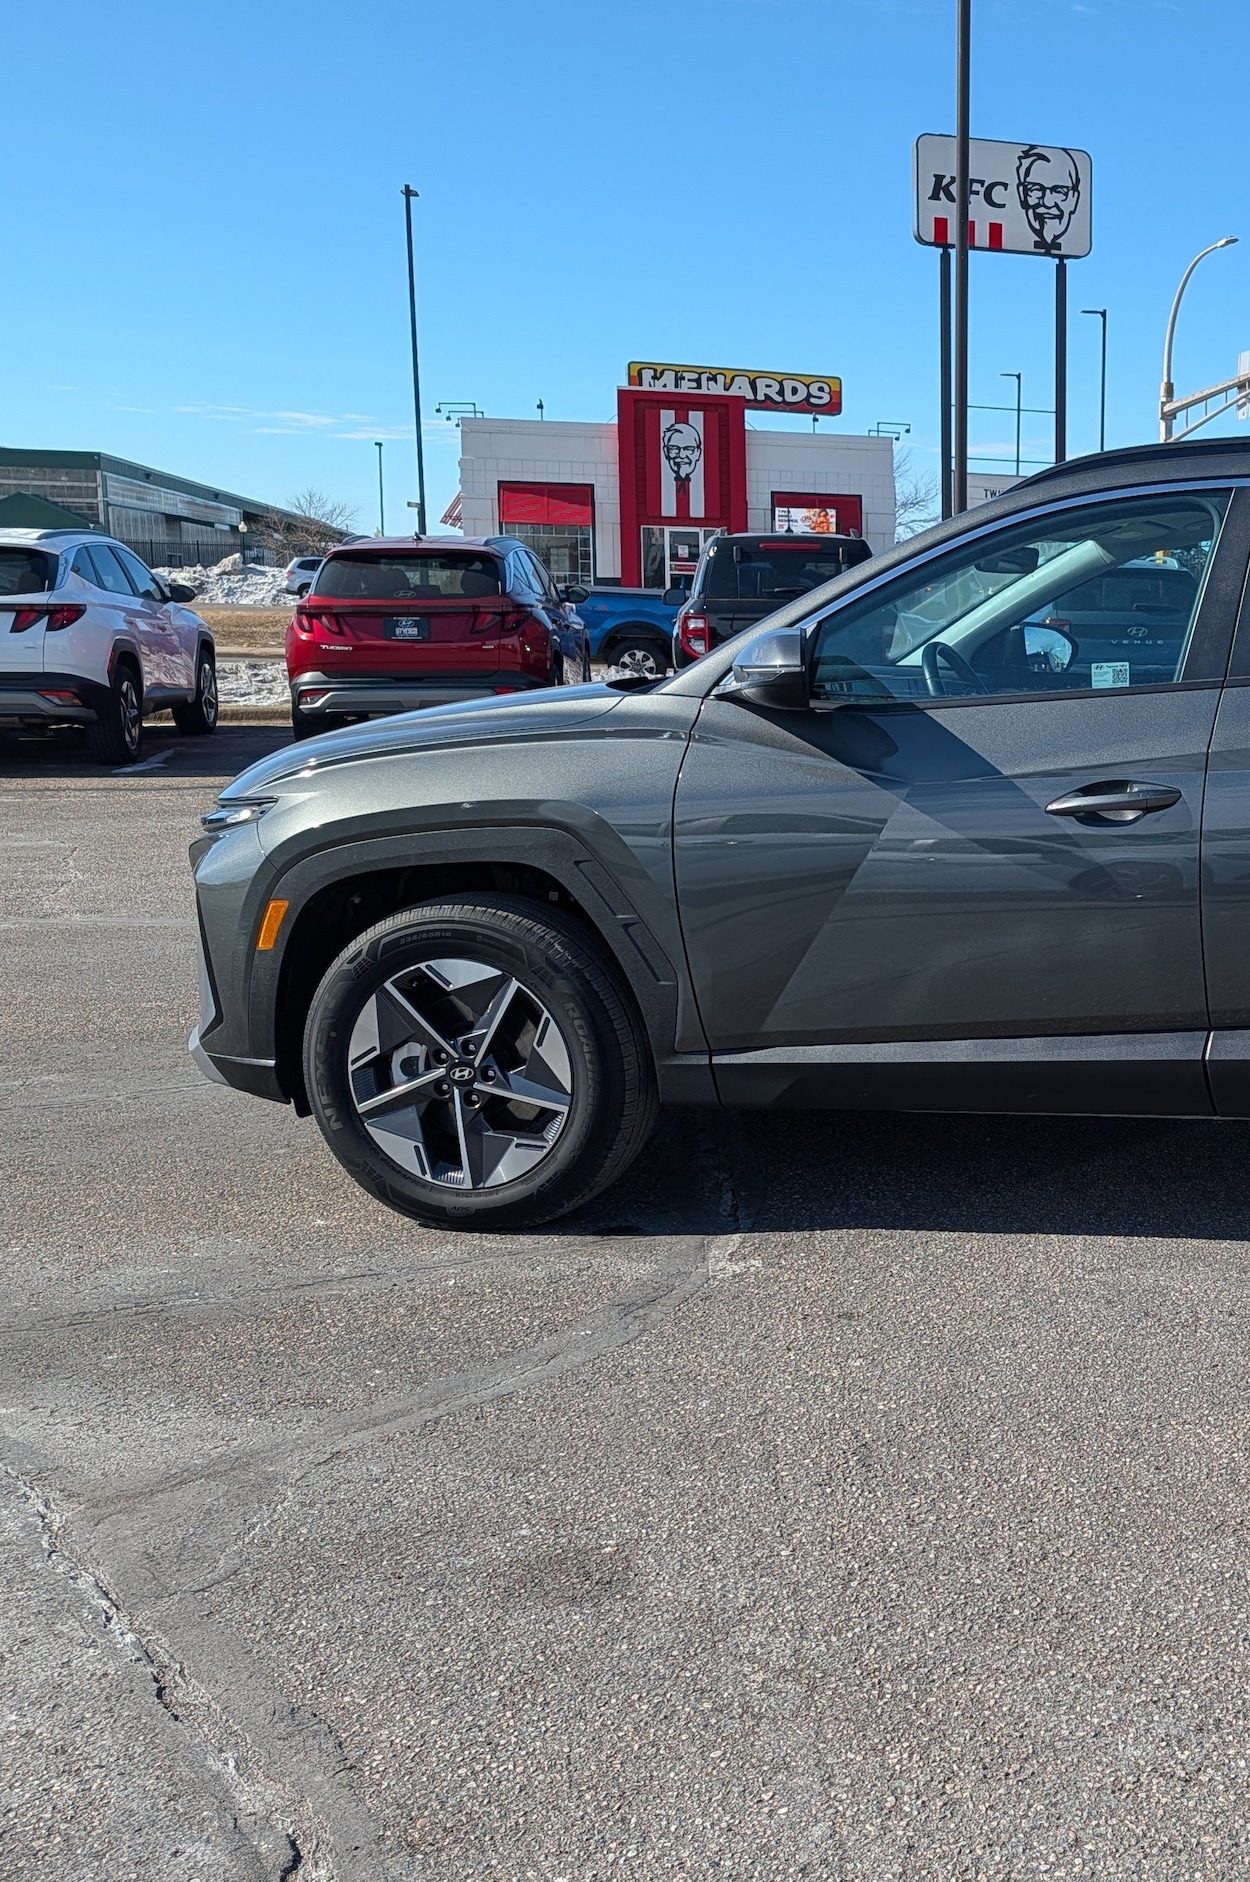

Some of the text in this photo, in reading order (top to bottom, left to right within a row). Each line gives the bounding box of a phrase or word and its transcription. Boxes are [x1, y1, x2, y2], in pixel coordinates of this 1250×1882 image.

[928, 173, 1009, 209] KFC
[641, 368, 832, 405] MENARDS
[320, 644, 353, 652] TUCSON
